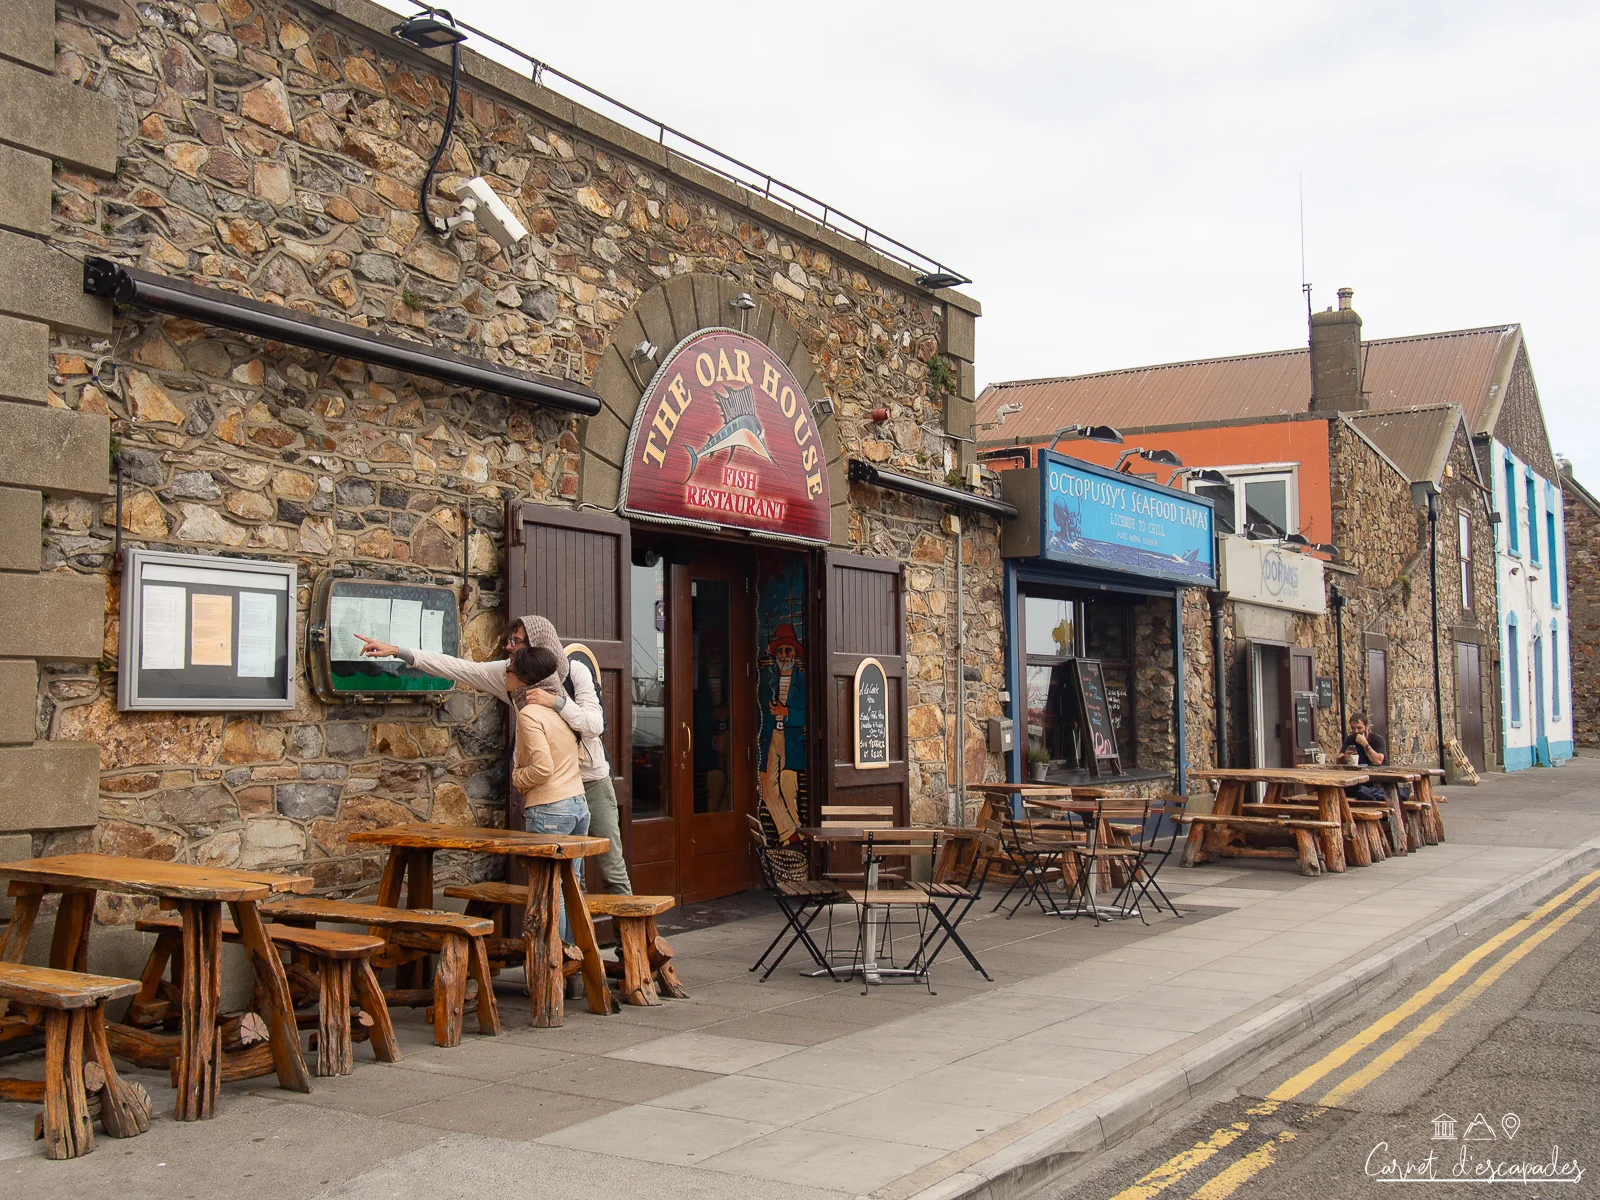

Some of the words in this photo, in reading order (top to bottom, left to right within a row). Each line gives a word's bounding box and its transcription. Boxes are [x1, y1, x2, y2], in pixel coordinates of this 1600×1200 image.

[642, 372, 693, 469] THE
[695, 347, 754, 387] OAR
[760, 359, 824, 501] HOUSE
[722, 466, 758, 492] FISH
[685, 486, 787, 521] RESTAURANT
[1049, 470, 1126, 510] OCTOPUSSY'S
[1131, 491, 1177, 523] SEAFOOD
[1179, 506, 1209, 531] TAPAS
[1138, 519, 1146, 532] TO
[1148, 522, 1166, 537] CHILL
